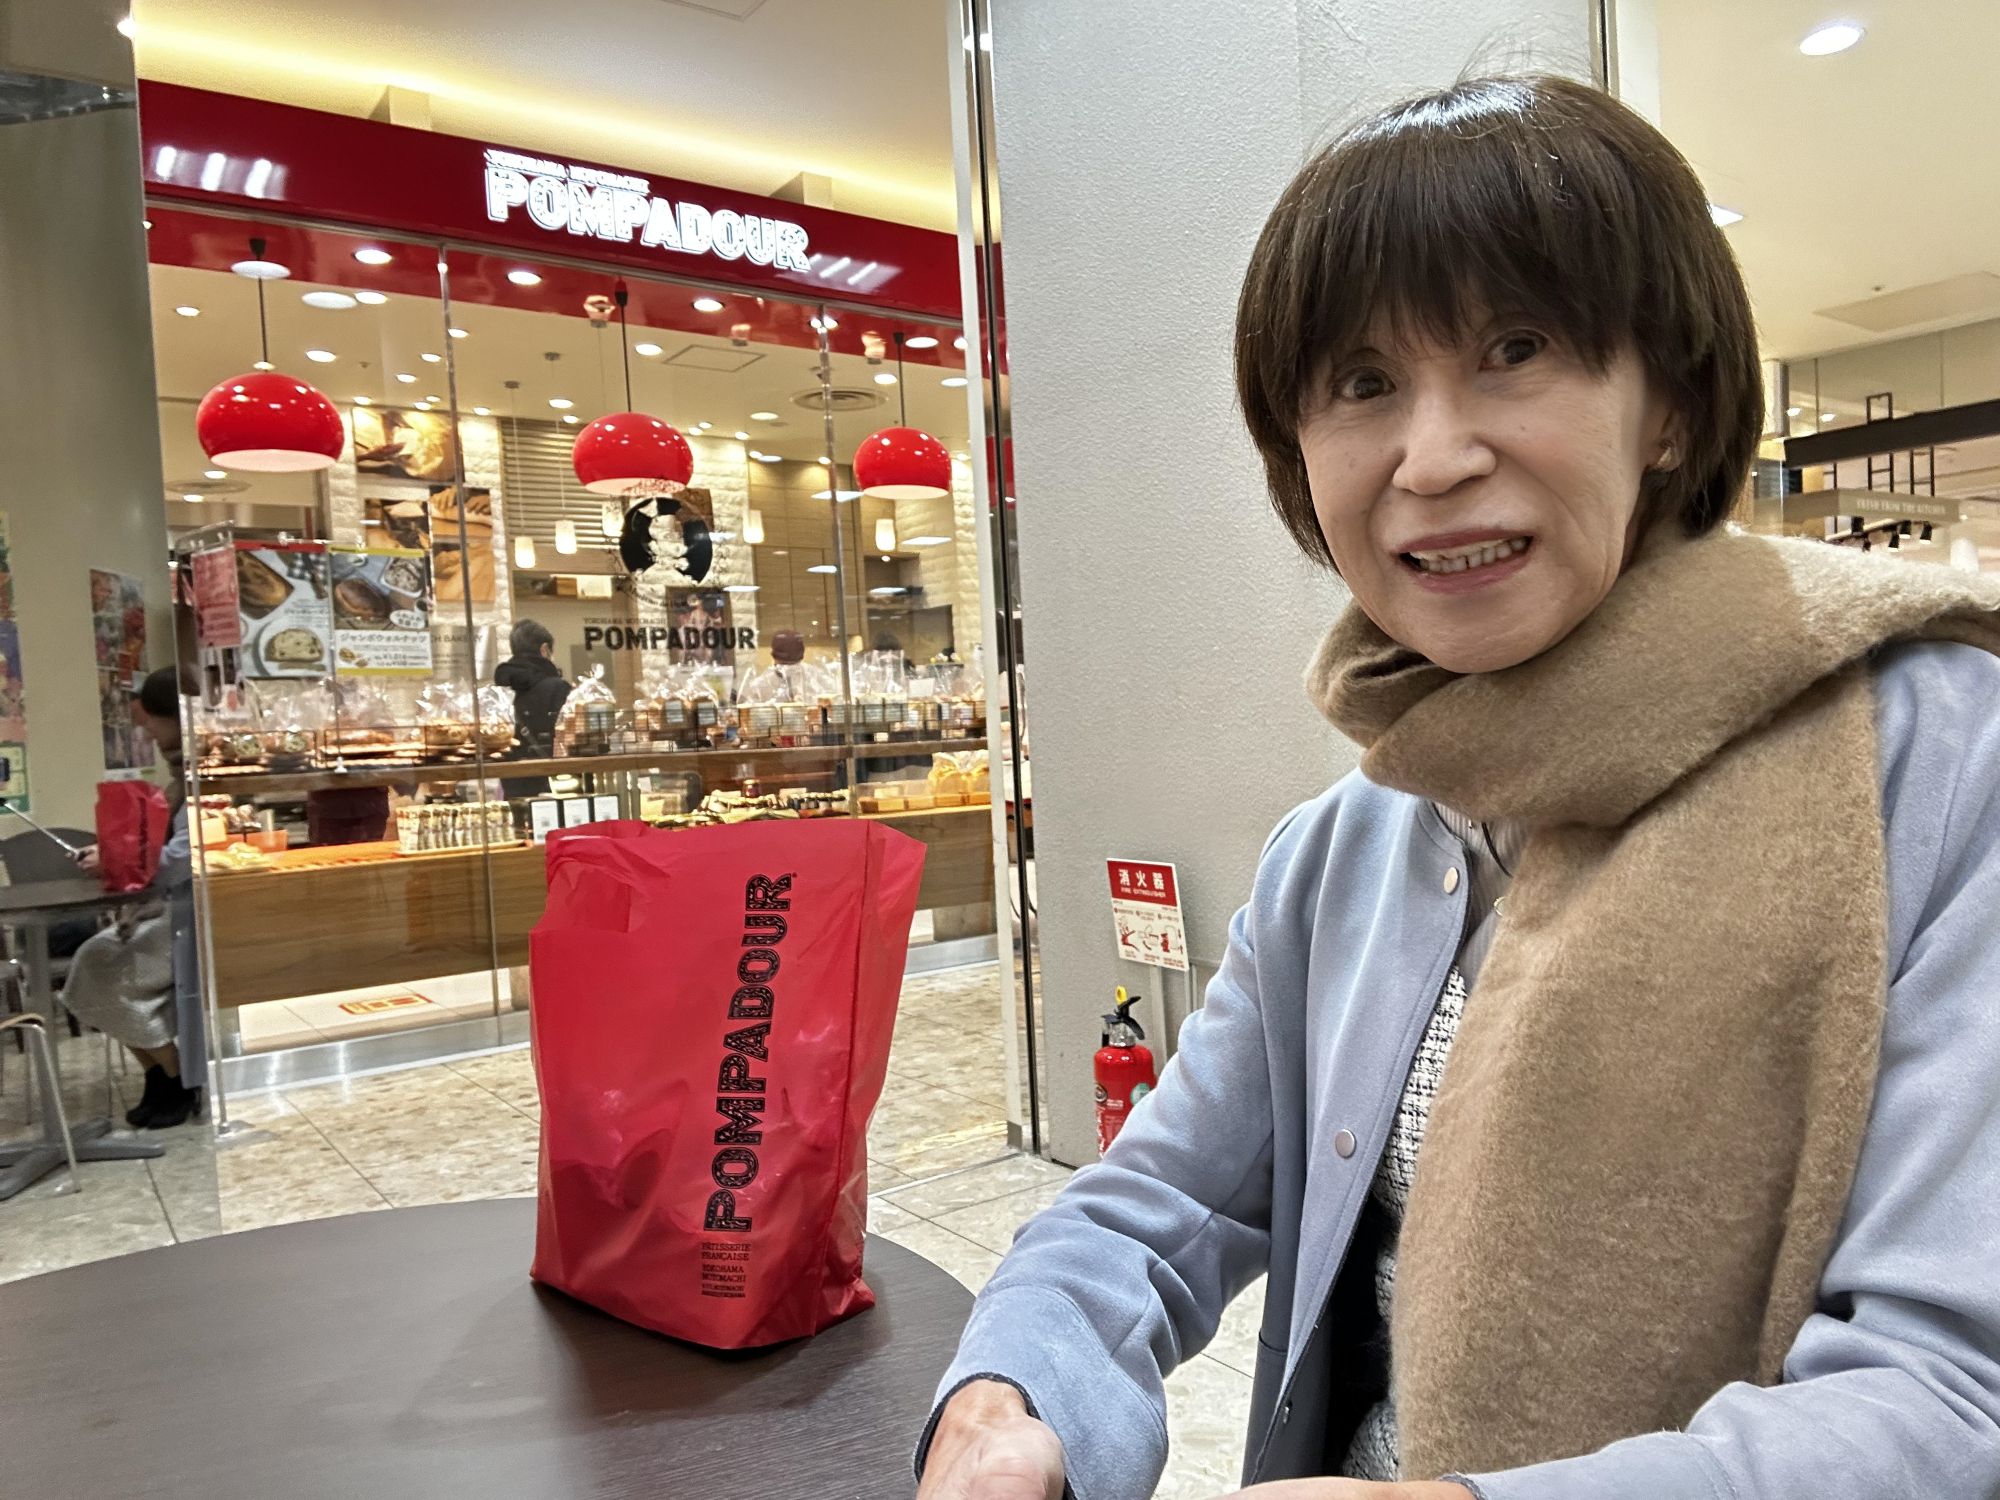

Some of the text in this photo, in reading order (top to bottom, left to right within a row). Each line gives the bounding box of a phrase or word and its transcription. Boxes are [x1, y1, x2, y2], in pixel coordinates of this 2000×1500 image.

[484, 166, 811, 272] POMPADOUR
[584, 626, 755, 650] POMPADOUR
[1118, 868, 1165, 890] 消火器
[703, 873, 793, 1232] POMPADOUR
